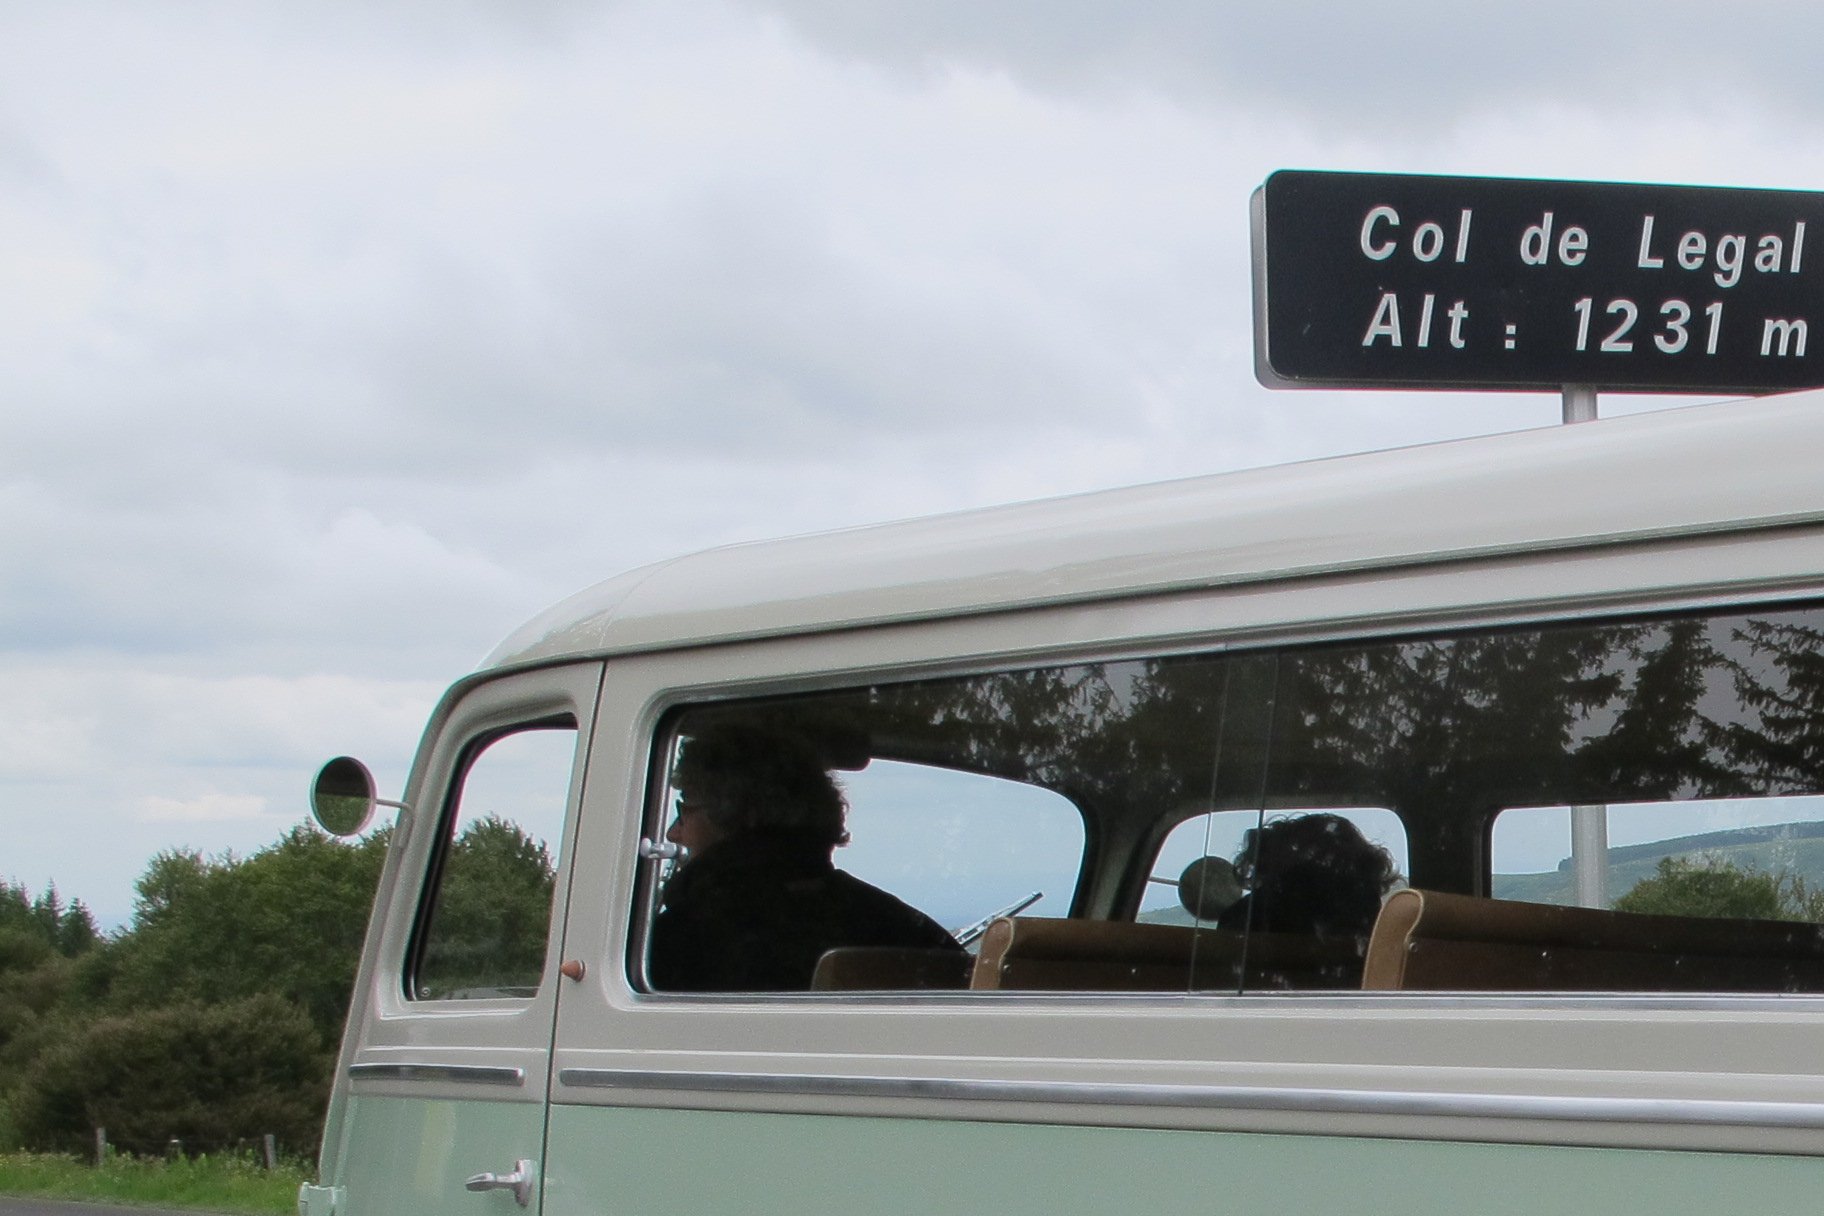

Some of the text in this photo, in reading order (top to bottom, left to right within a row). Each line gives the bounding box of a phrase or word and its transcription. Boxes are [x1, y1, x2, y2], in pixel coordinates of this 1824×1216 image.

[1360, 205, 1806, 289] Col de Legal
[1361, 292, 1469, 349] Alt
[1574, 297, 1723, 355] 1231
[1760, 318, 1808, 357] m
